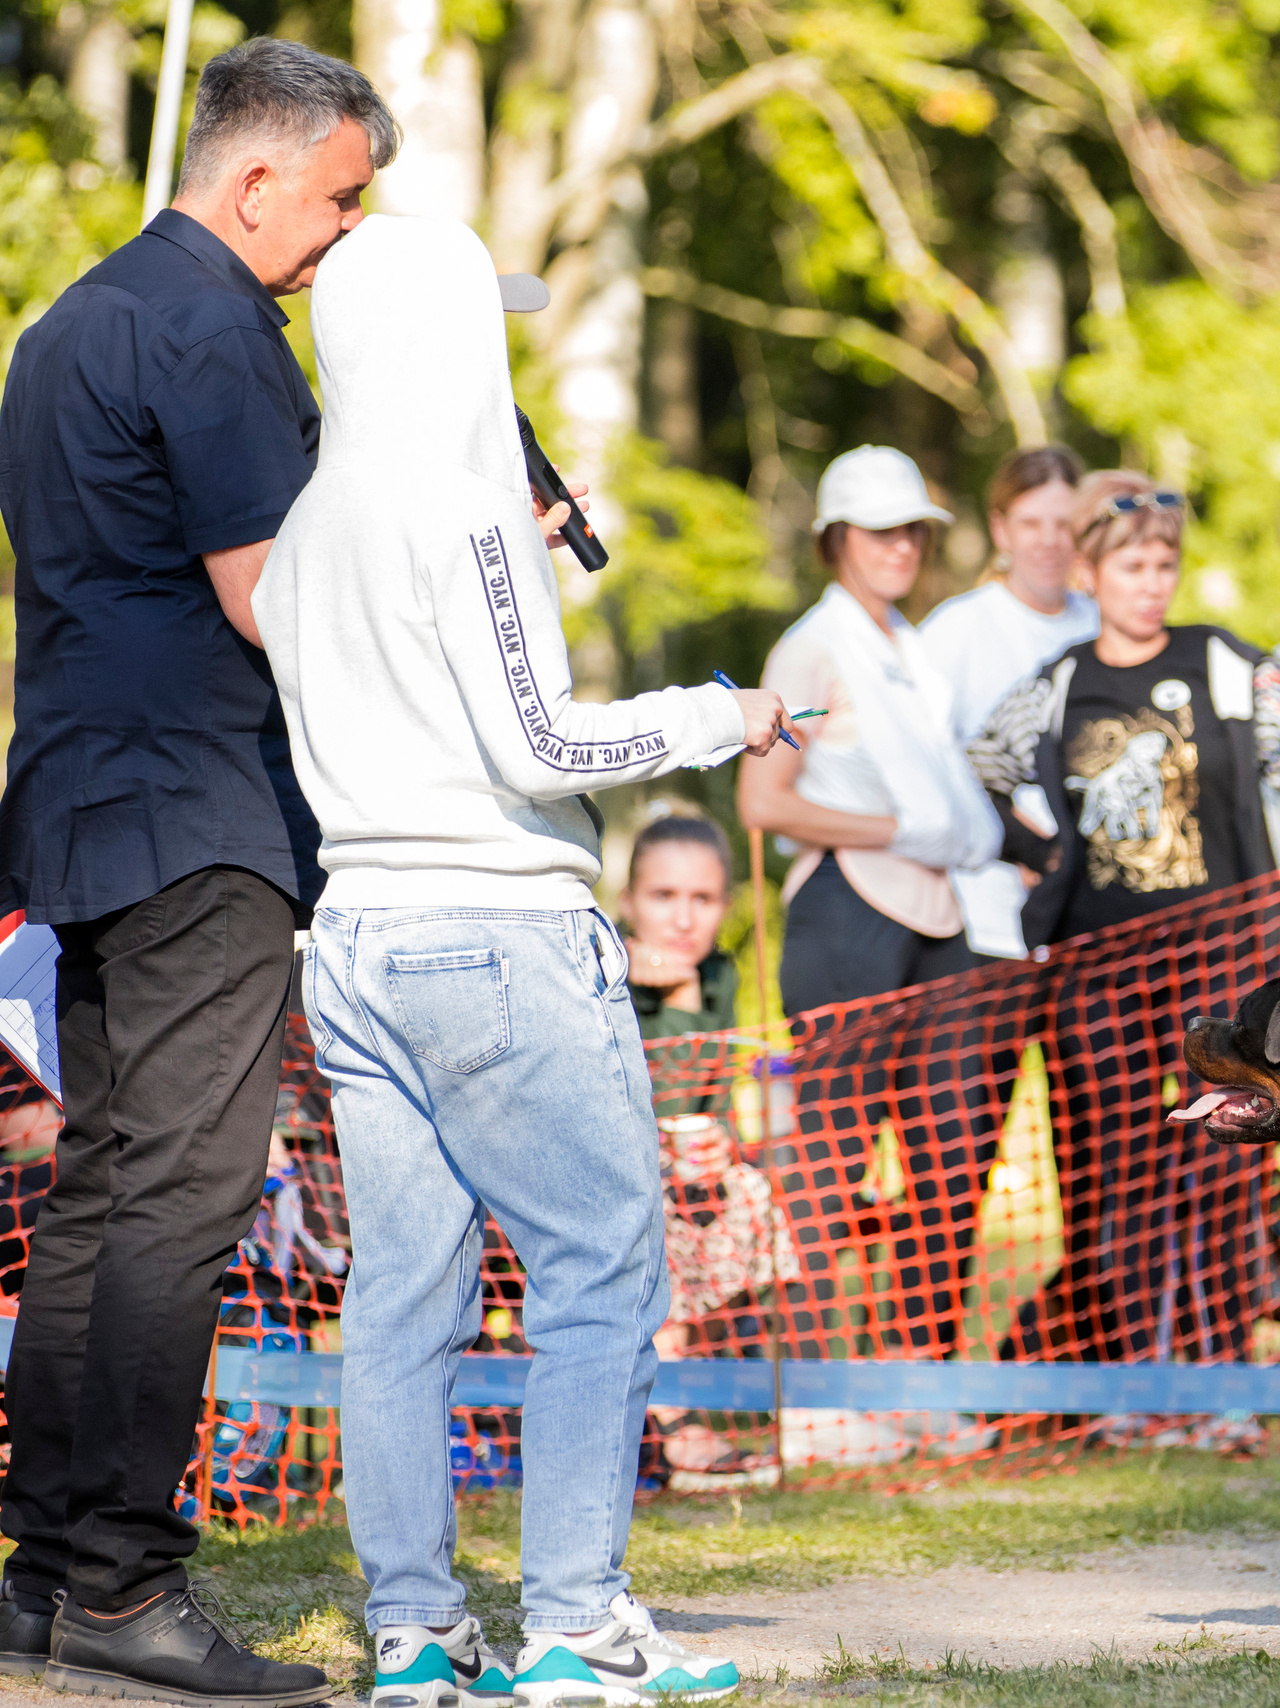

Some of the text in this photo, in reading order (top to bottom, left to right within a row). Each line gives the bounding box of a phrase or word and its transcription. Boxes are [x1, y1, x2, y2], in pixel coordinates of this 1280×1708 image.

[479, 528, 502, 568] NYC.
[490, 570, 511, 610] NYC.
[500, 613, 521, 655] NYC.
[510, 658, 533, 699] NYC.
[524, 700, 547, 738] NYC.
[382, 1654, 400, 1662] AIR
